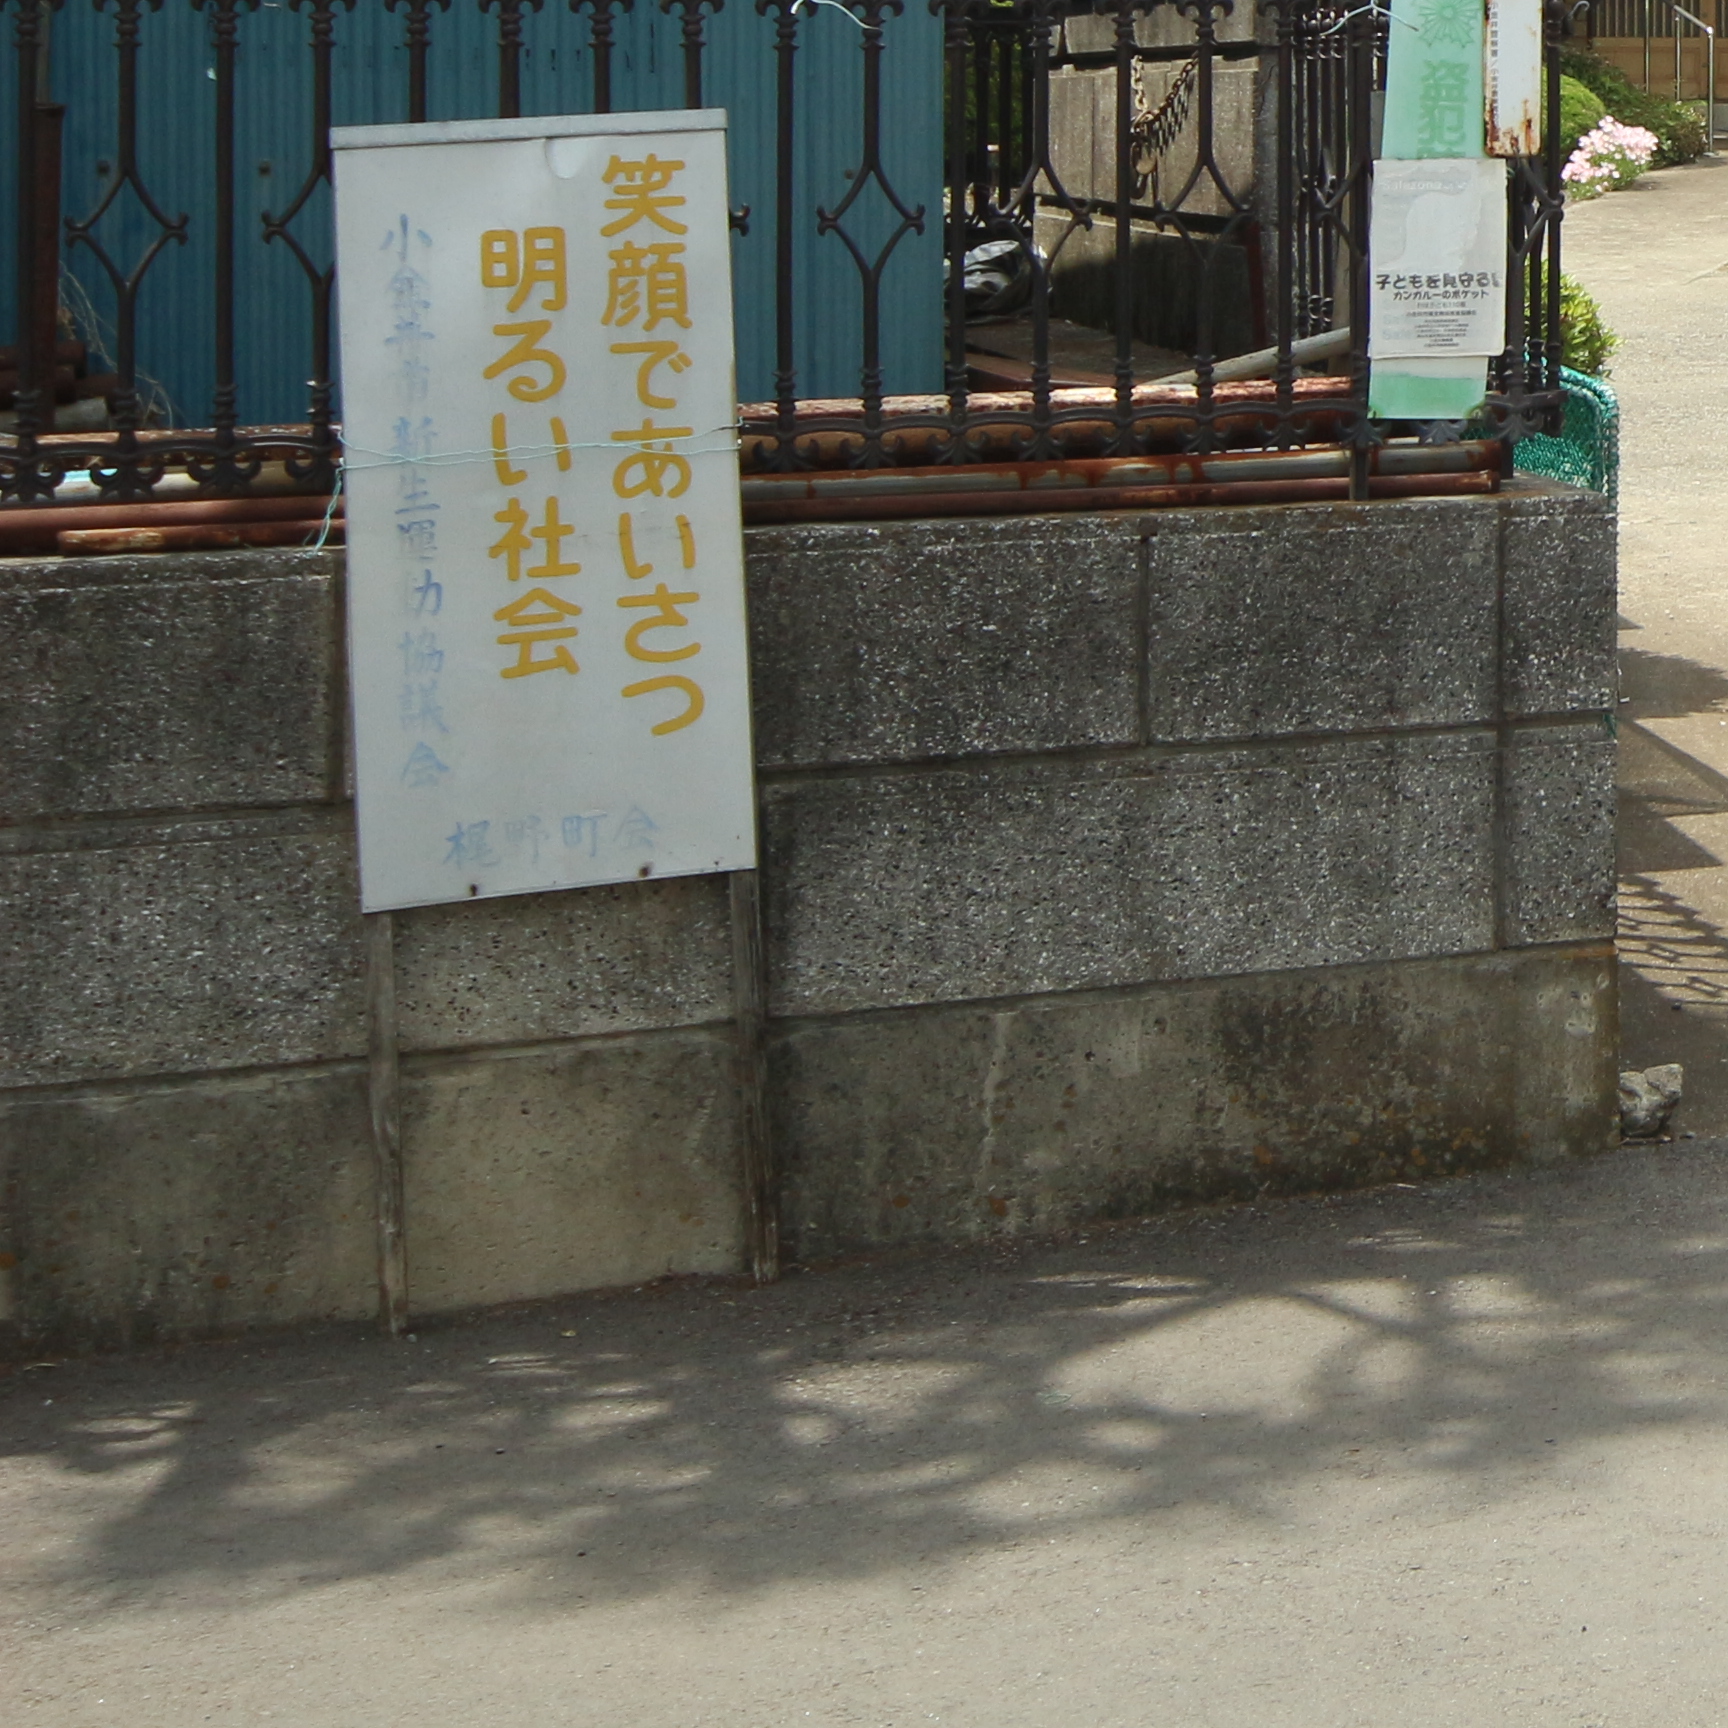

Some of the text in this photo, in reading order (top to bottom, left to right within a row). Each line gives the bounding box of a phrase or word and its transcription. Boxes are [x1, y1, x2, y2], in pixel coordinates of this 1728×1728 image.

[480, 224, 584, 680] 明るい社会
[600, 152, 707, 738] 笑顔であいさつ
[1393, 289, 1490, 302] カンガルーのポケット
